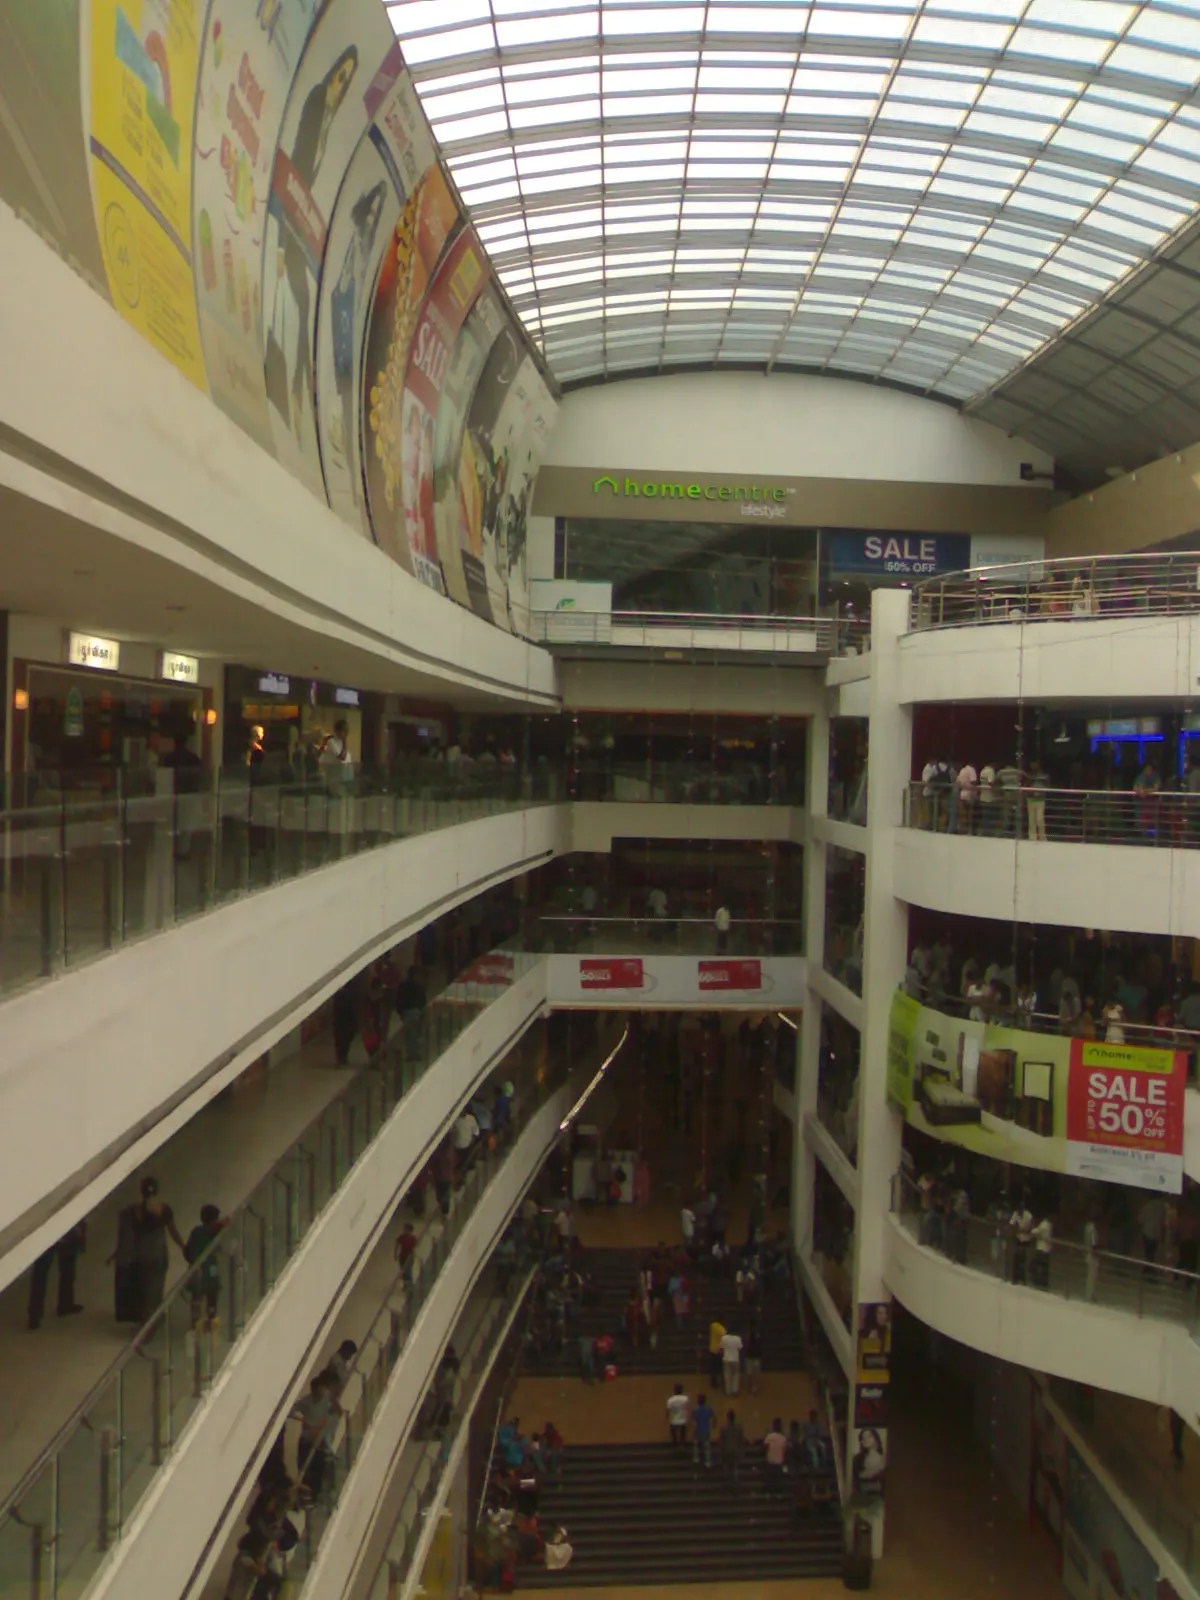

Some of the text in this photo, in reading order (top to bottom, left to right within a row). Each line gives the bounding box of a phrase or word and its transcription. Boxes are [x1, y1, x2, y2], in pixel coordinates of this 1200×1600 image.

[624, 476, 787, 502] homecentre
[864, 536, 936, 561] SALE
[912, 562, 936, 573] OFF
[1087, 1072, 1167, 1106] SALE
[1098, 1101, 1165, 1136] 50%
